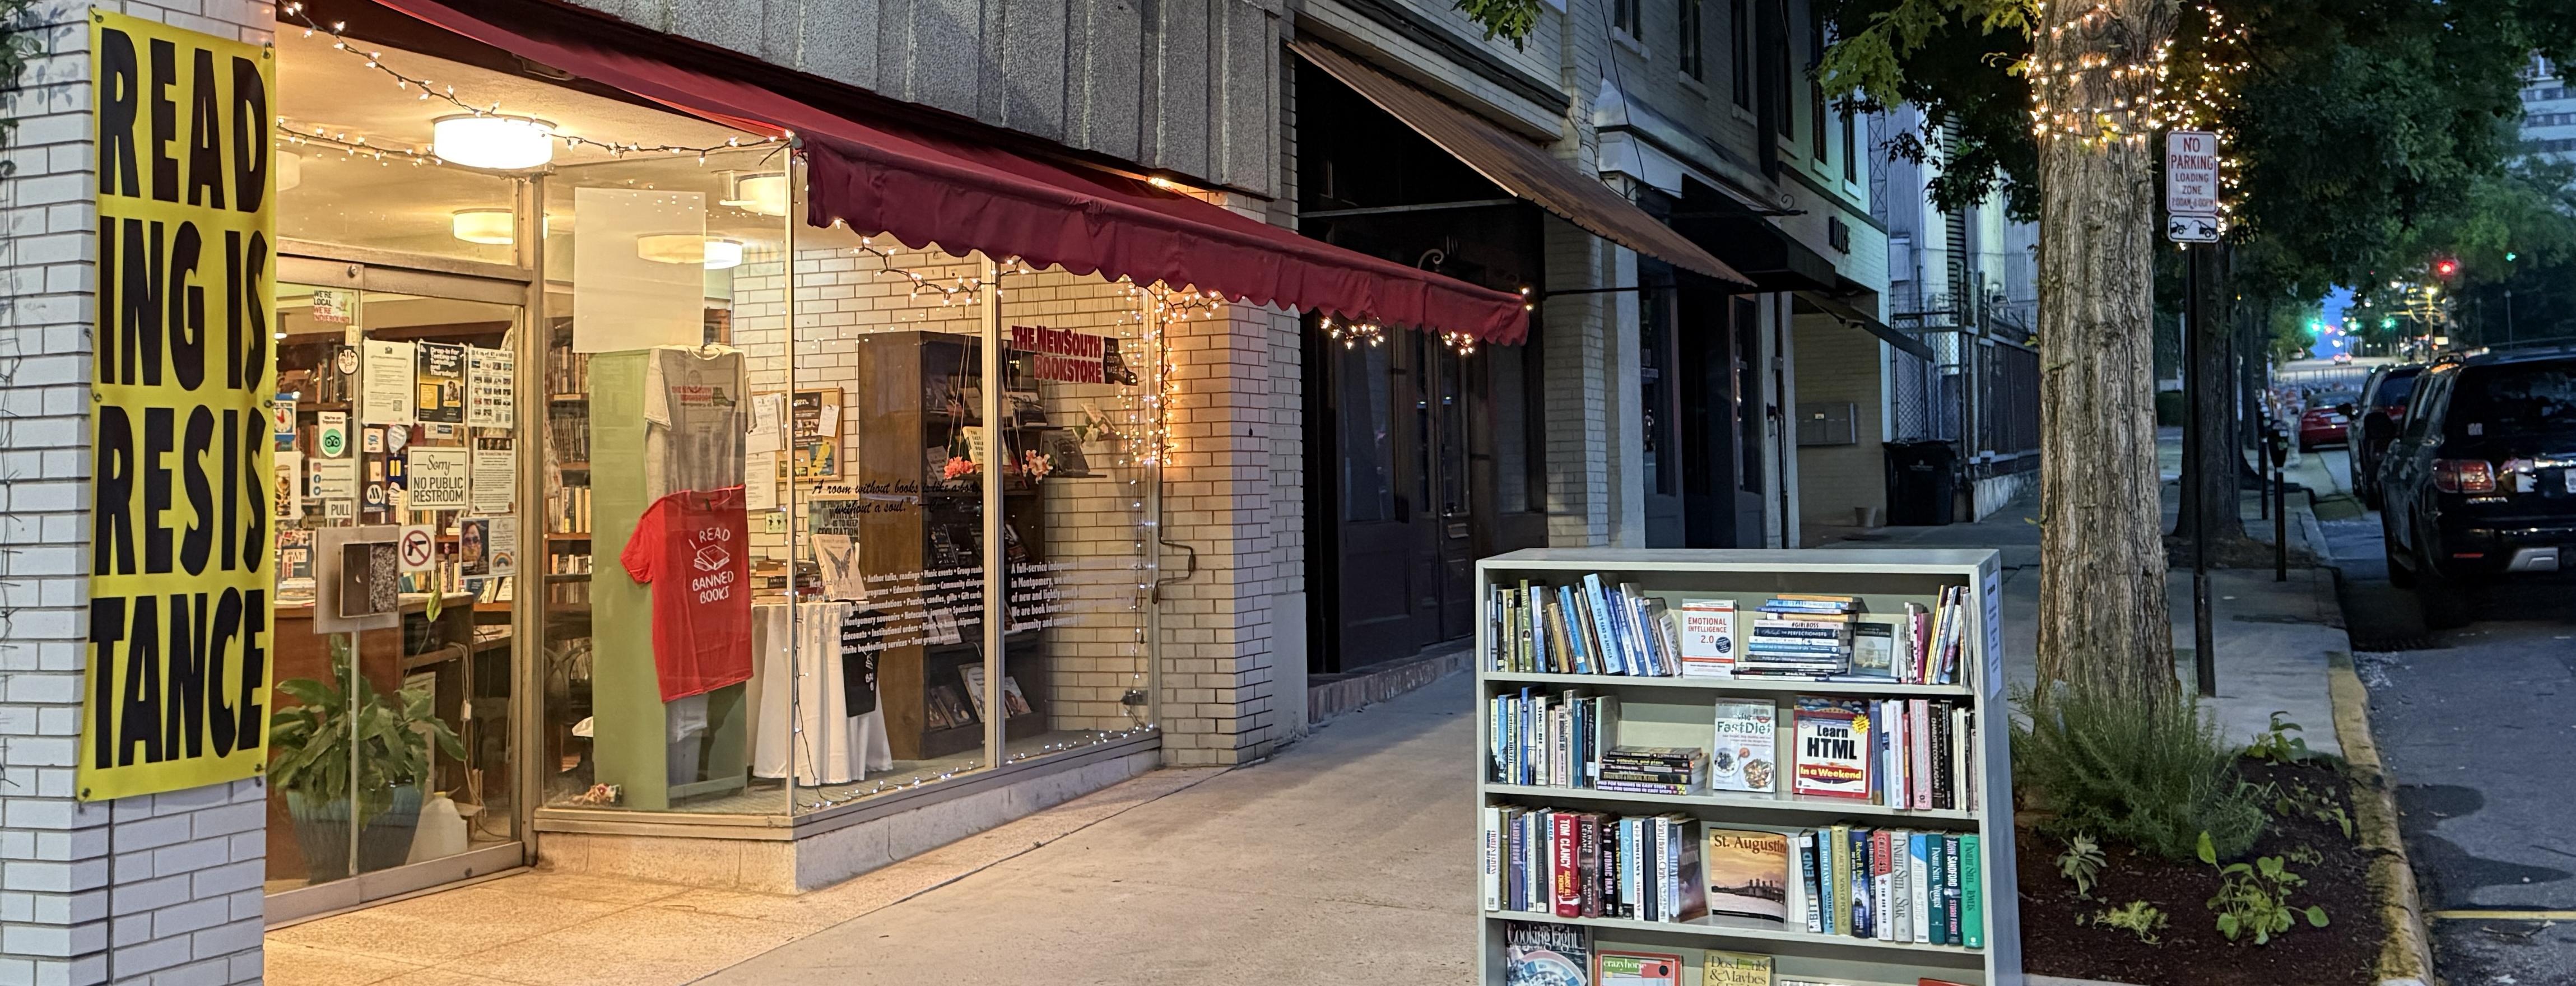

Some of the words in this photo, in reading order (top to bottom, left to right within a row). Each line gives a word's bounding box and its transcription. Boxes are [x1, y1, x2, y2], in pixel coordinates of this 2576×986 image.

[100, 27, 267, 213] READ
[2183, 137, 2201, 152] NO
[2170, 155, 2213, 170] PARKING
[2175, 173, 2209, 183] LOADING
[2182, 185, 2202, 195] ZONE
[314, 290, 332, 299] WE'RE
[314, 298, 332, 306] LOCAL
[99, 216, 206, 391] ING
[225, 231, 268, 394] IS
[1012, 325, 1035, 351] THE
[1034, 355, 1102, 383] BOOKSTORE
[427, 454, 450, 476] Sorry
[94, 404, 267, 576] RESIS
[413, 477, 427, 489] NO
[430, 477, 463, 489] PUBLIC
[827, 485, 850, 494] room
[855, 480, 890, 494] without
[894, 479, 918, 494] books
[413, 490, 463, 503] RESTROOM
[331, 504, 350, 515] PULL
[835, 502, 871, 514] without
[699, 527, 730, 543] READ
[924, 569, 937, 578] Music
[957, 567, 970, 576] Group
[1011, 564, 1016, 574] A
[1017, 561, 1047, 573] full-service
[692, 571, 734, 591] BANNED
[700, 586, 729, 604] BOOKS
[1011, 592, 1017, 603] of
[1032, 589, 1042, 601] and
[1043, 588, 1061, 602] lightly
[1011, 606, 1020, 617] We
[1031, 603, 1045, 615] book
[843, 630, 867, 640] discounts
[903, 624, 918, 632] orders
[958, 617, 980, 627] shipments
[1042, 616, 1053, 627] and
[1688, 617, 1727, 625] EMOTIONAL
[1700, 635, 1714, 644] 2.0
[89, 588, 265, 770] TANCE
[1717, 721, 1771, 734] FastDiet
[1817, 725, 1848, 738] Learn
[1807, 737, 1857, 760] HTML
[1800, 767, 1807, 775] In
[1817, 768, 1862, 779] Weekend
[1559, 819, 1570, 836] TOM
[1658, 820, 1666, 838] Mary
[1714, 835, 1730, 847] St.
[1878, 836, 1886, 858] CHILD
[1946, 840, 1957, 855] JOHN
[1513, 844, 1521, 866] BROWN
[1560, 836, 1571, 869] CLANCY
[1893, 838, 1907, 868] DANIELLE
[1932, 847, 1941, 867] DANIELLE
[1965, 842, 1975, 866] DANIELLE
[1604, 850, 1612, 876] ATOMIC
[1658, 861, 1667, 881] Clark
[1802, 852, 1815, 879] END
[1947, 855, 1957, 887] SANDFORD
[1605, 878, 1613, 895] IRAN
[1806, 880, 1819, 923] BITTER
[1895, 897, 1910, 919] STAR
[1965, 887, 1976, 912] JEWELS
[1508, 923, 1551, 951] Cooking
[1551, 923, 1578, 952] Light
[1603, 959, 1647, 971] crazyhorse
[1726, 970, 1766, 985] Maybes
